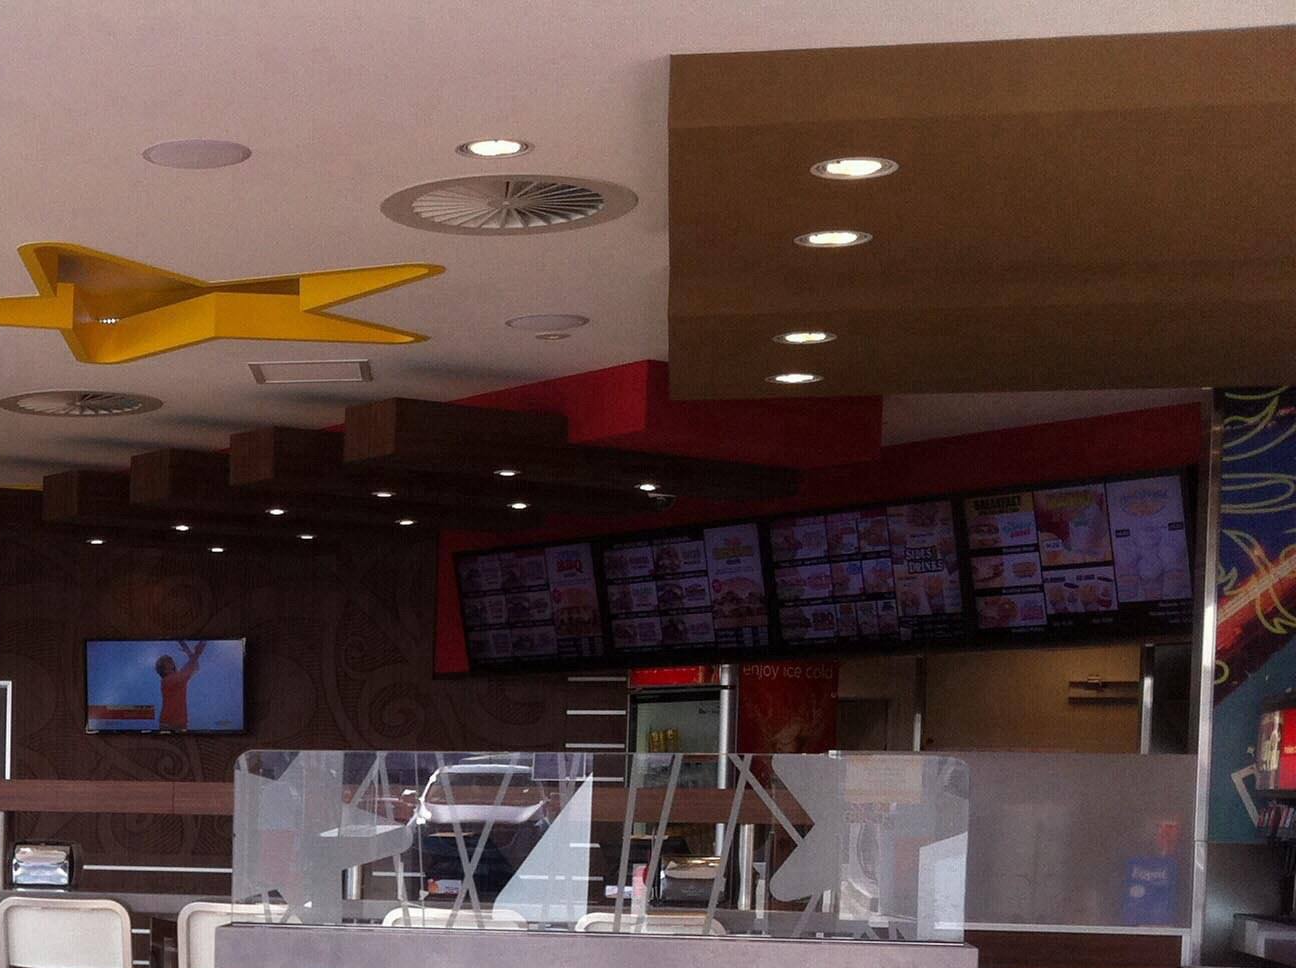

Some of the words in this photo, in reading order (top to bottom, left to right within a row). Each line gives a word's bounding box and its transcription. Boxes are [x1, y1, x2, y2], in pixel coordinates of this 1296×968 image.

[743, 663, 780, 680] enjoy
[783, 665, 802, 679] ice
[806, 663, 833, 679] cold
